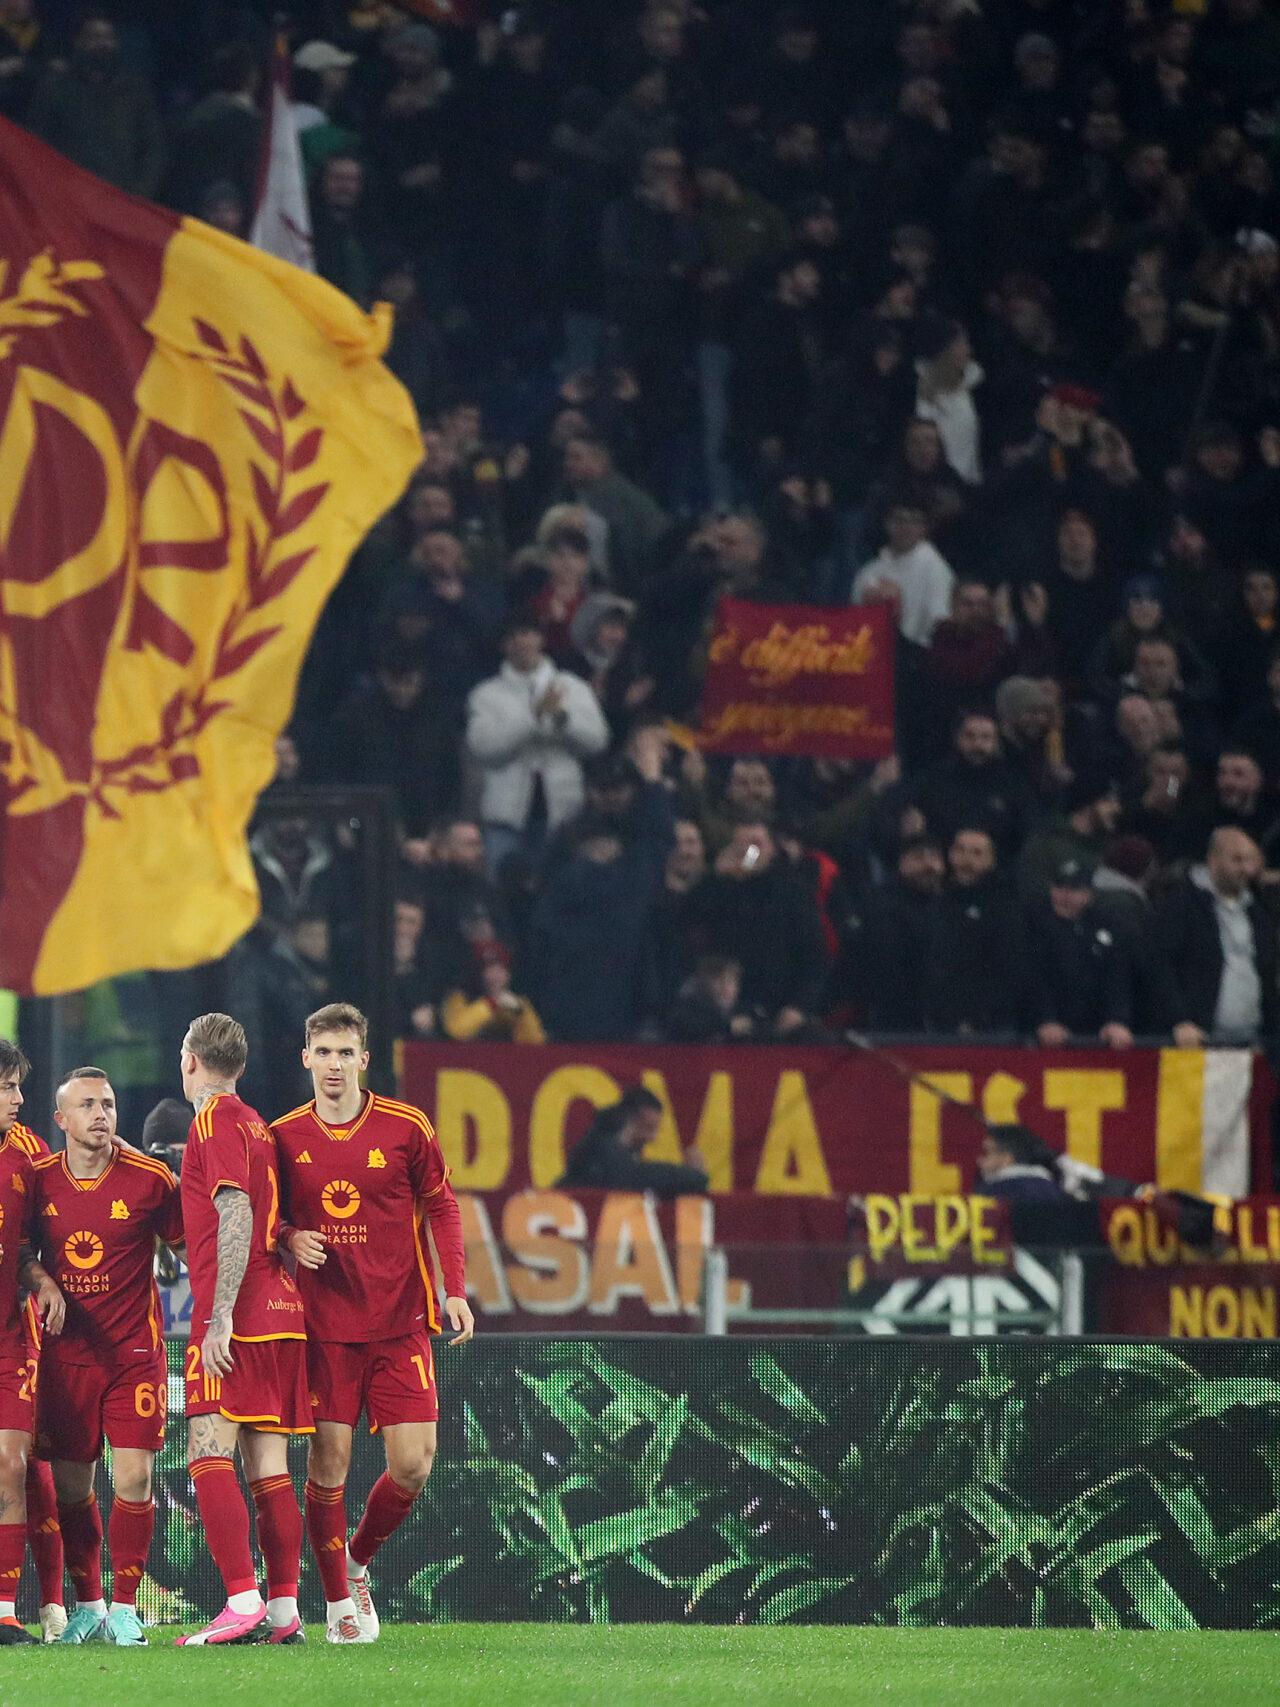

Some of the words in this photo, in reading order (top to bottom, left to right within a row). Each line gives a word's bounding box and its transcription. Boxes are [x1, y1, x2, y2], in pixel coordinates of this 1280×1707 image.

[321, 1224, 367, 1234] RIYADH
[865, 1193, 1007, 1265] PEPE
[62, 1273, 110, 1284] RIYADH
[63, 1283, 110, 1294] SEASON
[266, 1298, 297, 1313] Auberge
[1171, 1285, 1276, 1338] NON
[186, 1345, 200, 1381] 2
[135, 1382, 167, 1418] 69
